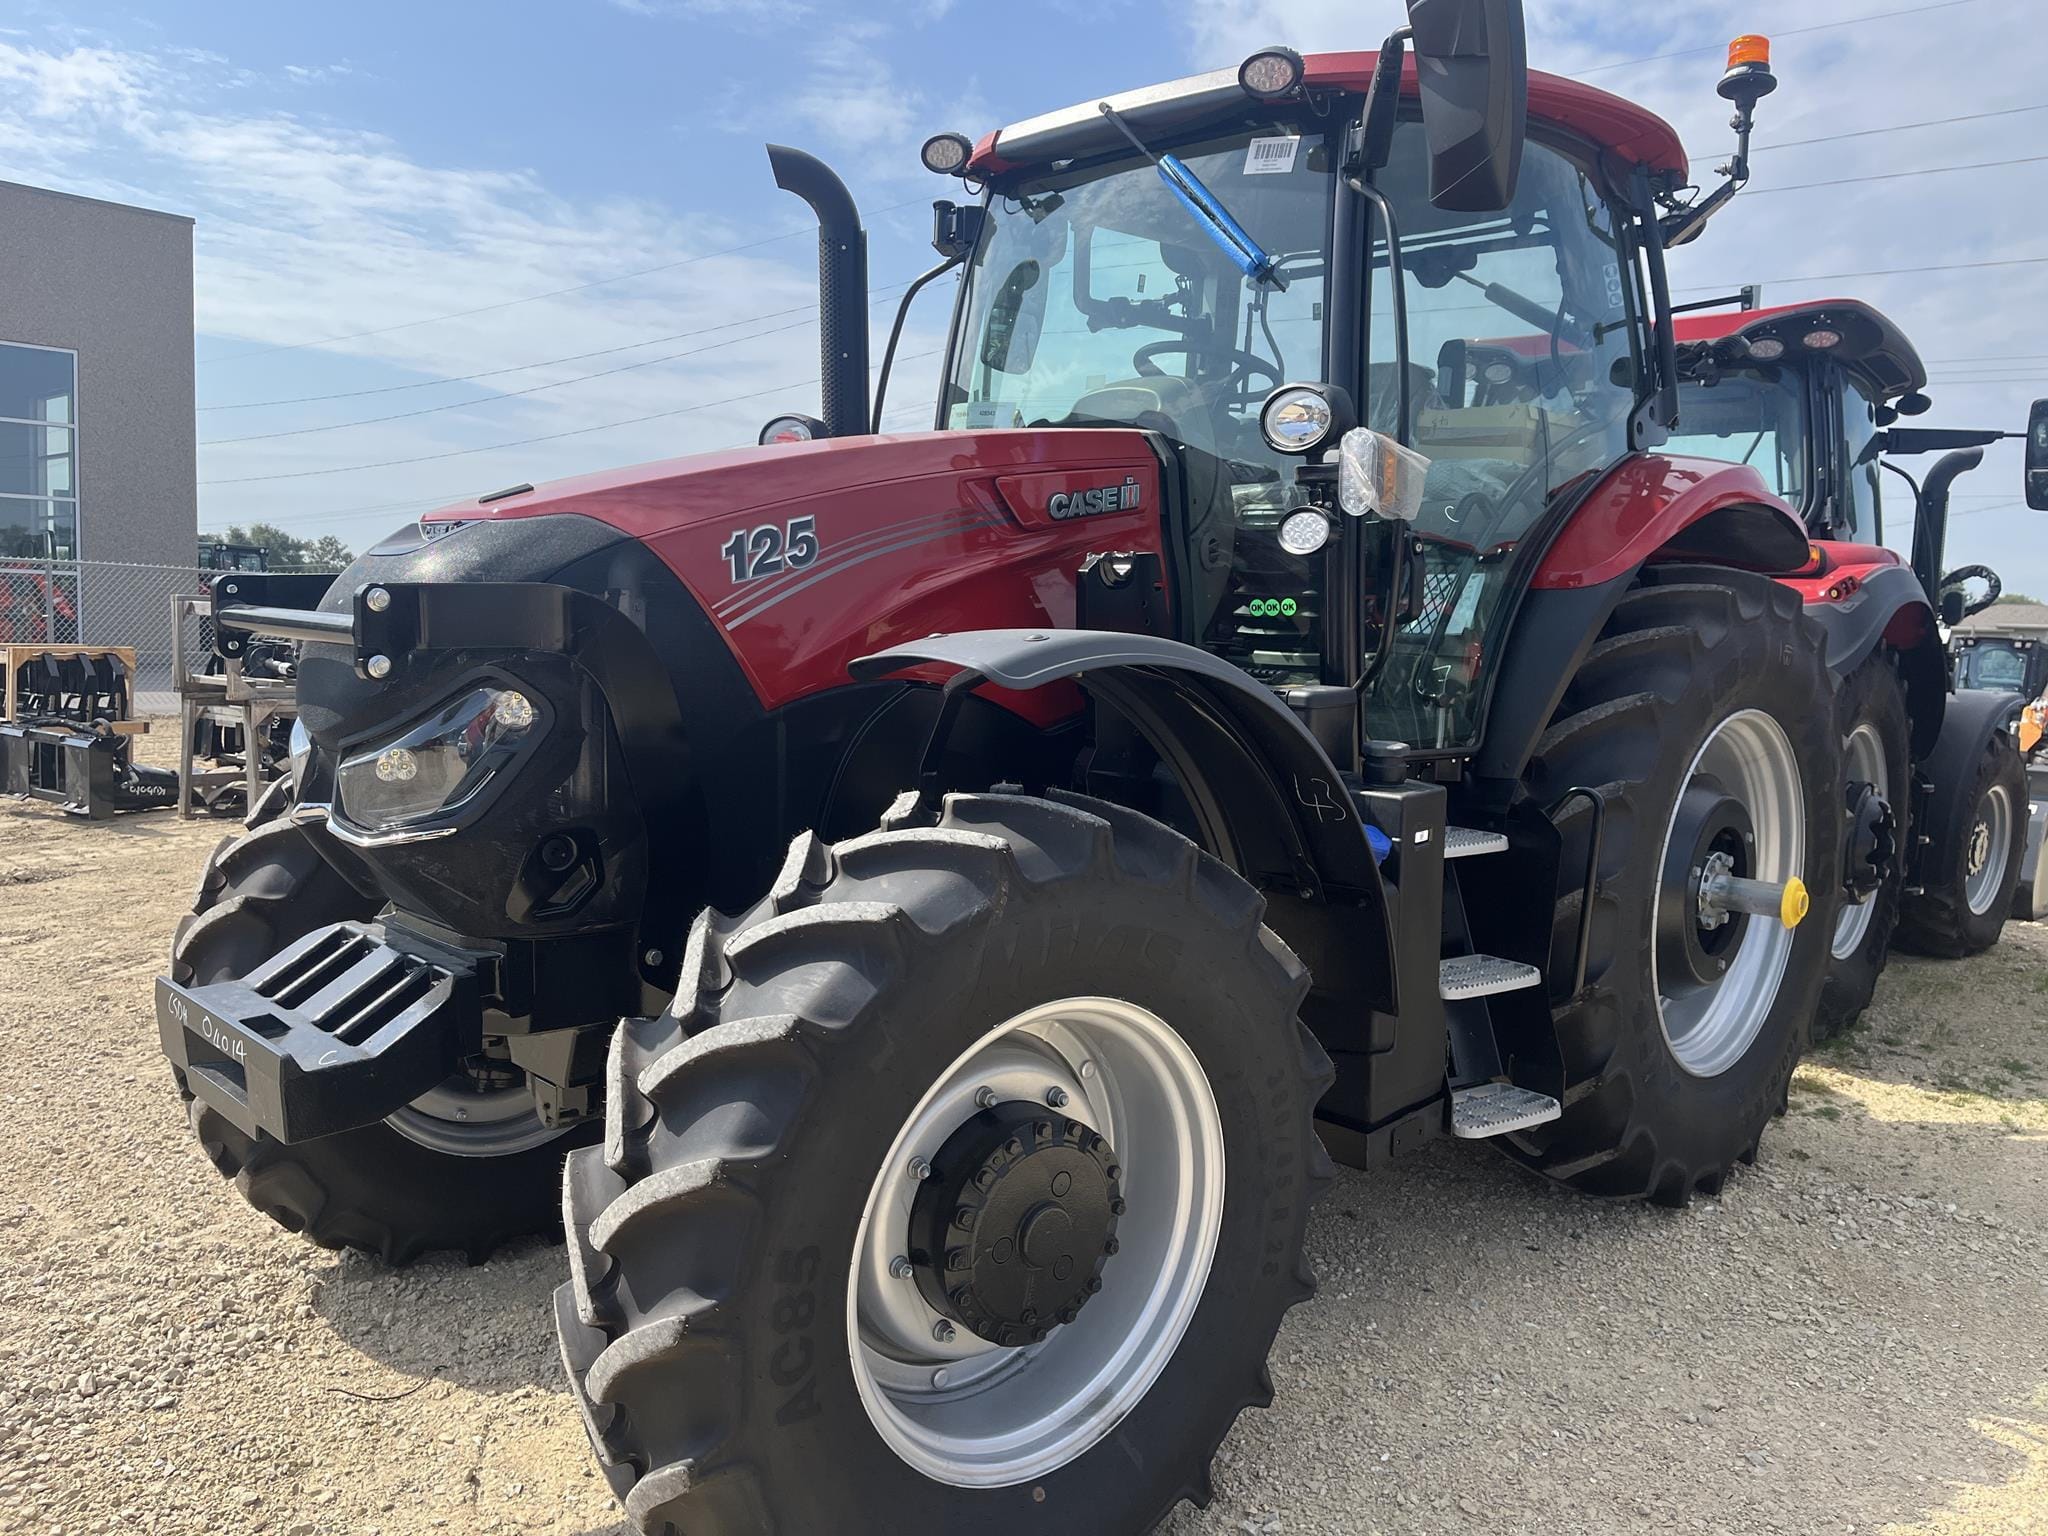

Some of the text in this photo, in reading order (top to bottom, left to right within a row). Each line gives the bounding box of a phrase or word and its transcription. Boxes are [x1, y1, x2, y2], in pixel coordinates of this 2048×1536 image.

[1050, 486, 1118, 520] CASE
[721, 514, 819, 584] 125
[1251, 602, 1295, 612] OK OK OK
[129, 786, 166, 796] Kubota
[1293, 773, 1347, 823] 43
[769, 1245, 823, 1427] AC85
